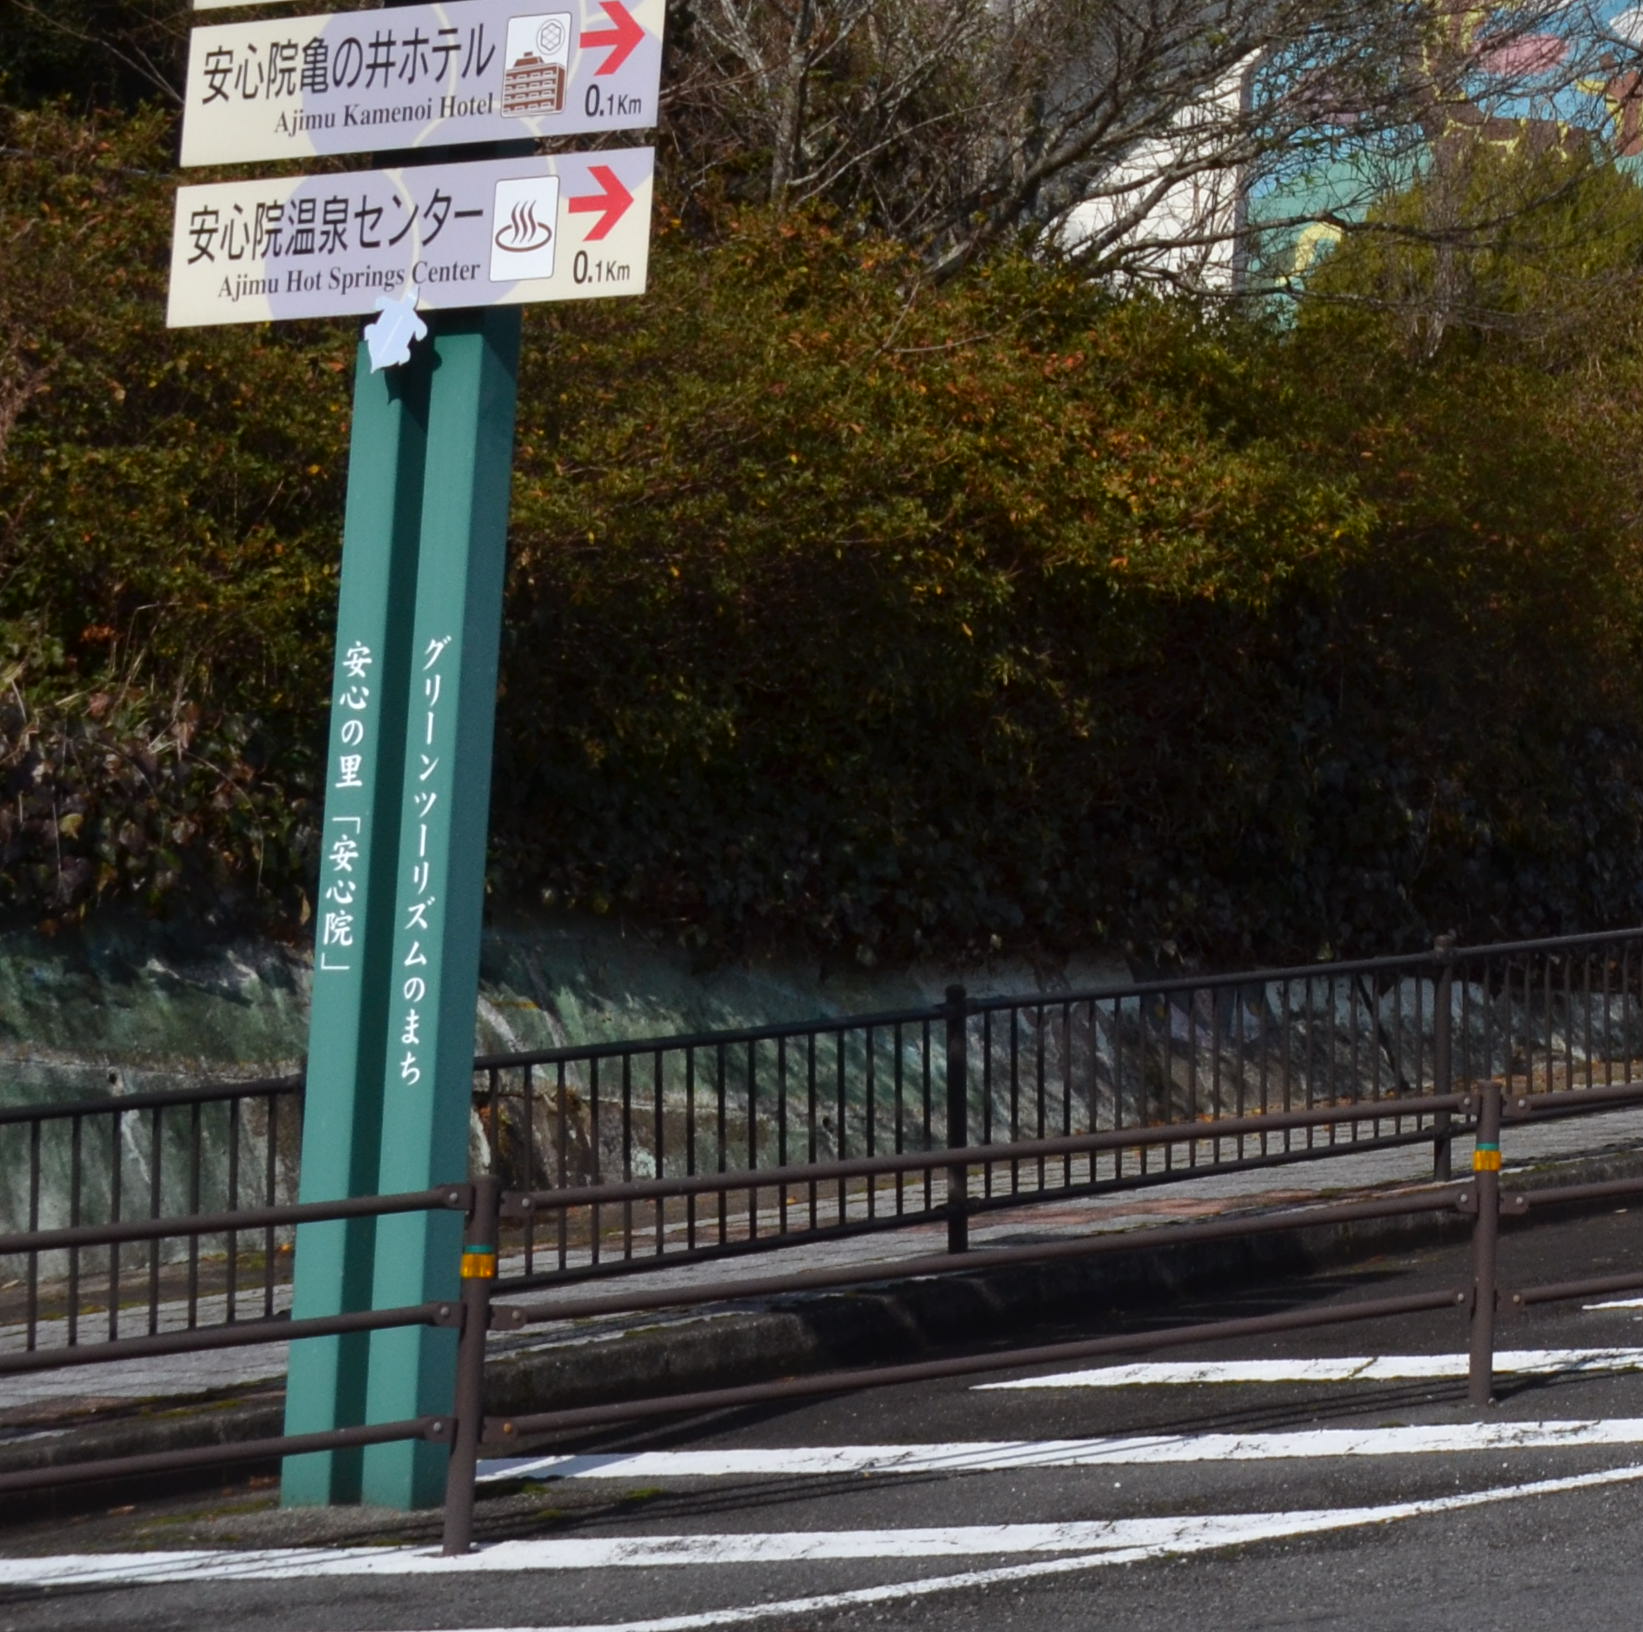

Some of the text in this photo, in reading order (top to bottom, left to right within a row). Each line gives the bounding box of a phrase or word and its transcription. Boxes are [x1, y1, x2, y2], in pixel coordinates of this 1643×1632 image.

[201, 23, 496, 106] 安心院亀の井ホテル
[274, 92, 494, 137] Ajimu Kamenoi Hotel
[584, 83, 642, 117] 0.1Km
[186, 188, 484, 266] 安心院温泉センター
[218, 260, 481, 299] Ajimu Hot Springs Center
[573, 251, 631, 284] 0.1Km
[320, 640, 373, 971] 安心の里「安心院」
[399, 635, 452, 1086] グリーンツーリズムのまち
